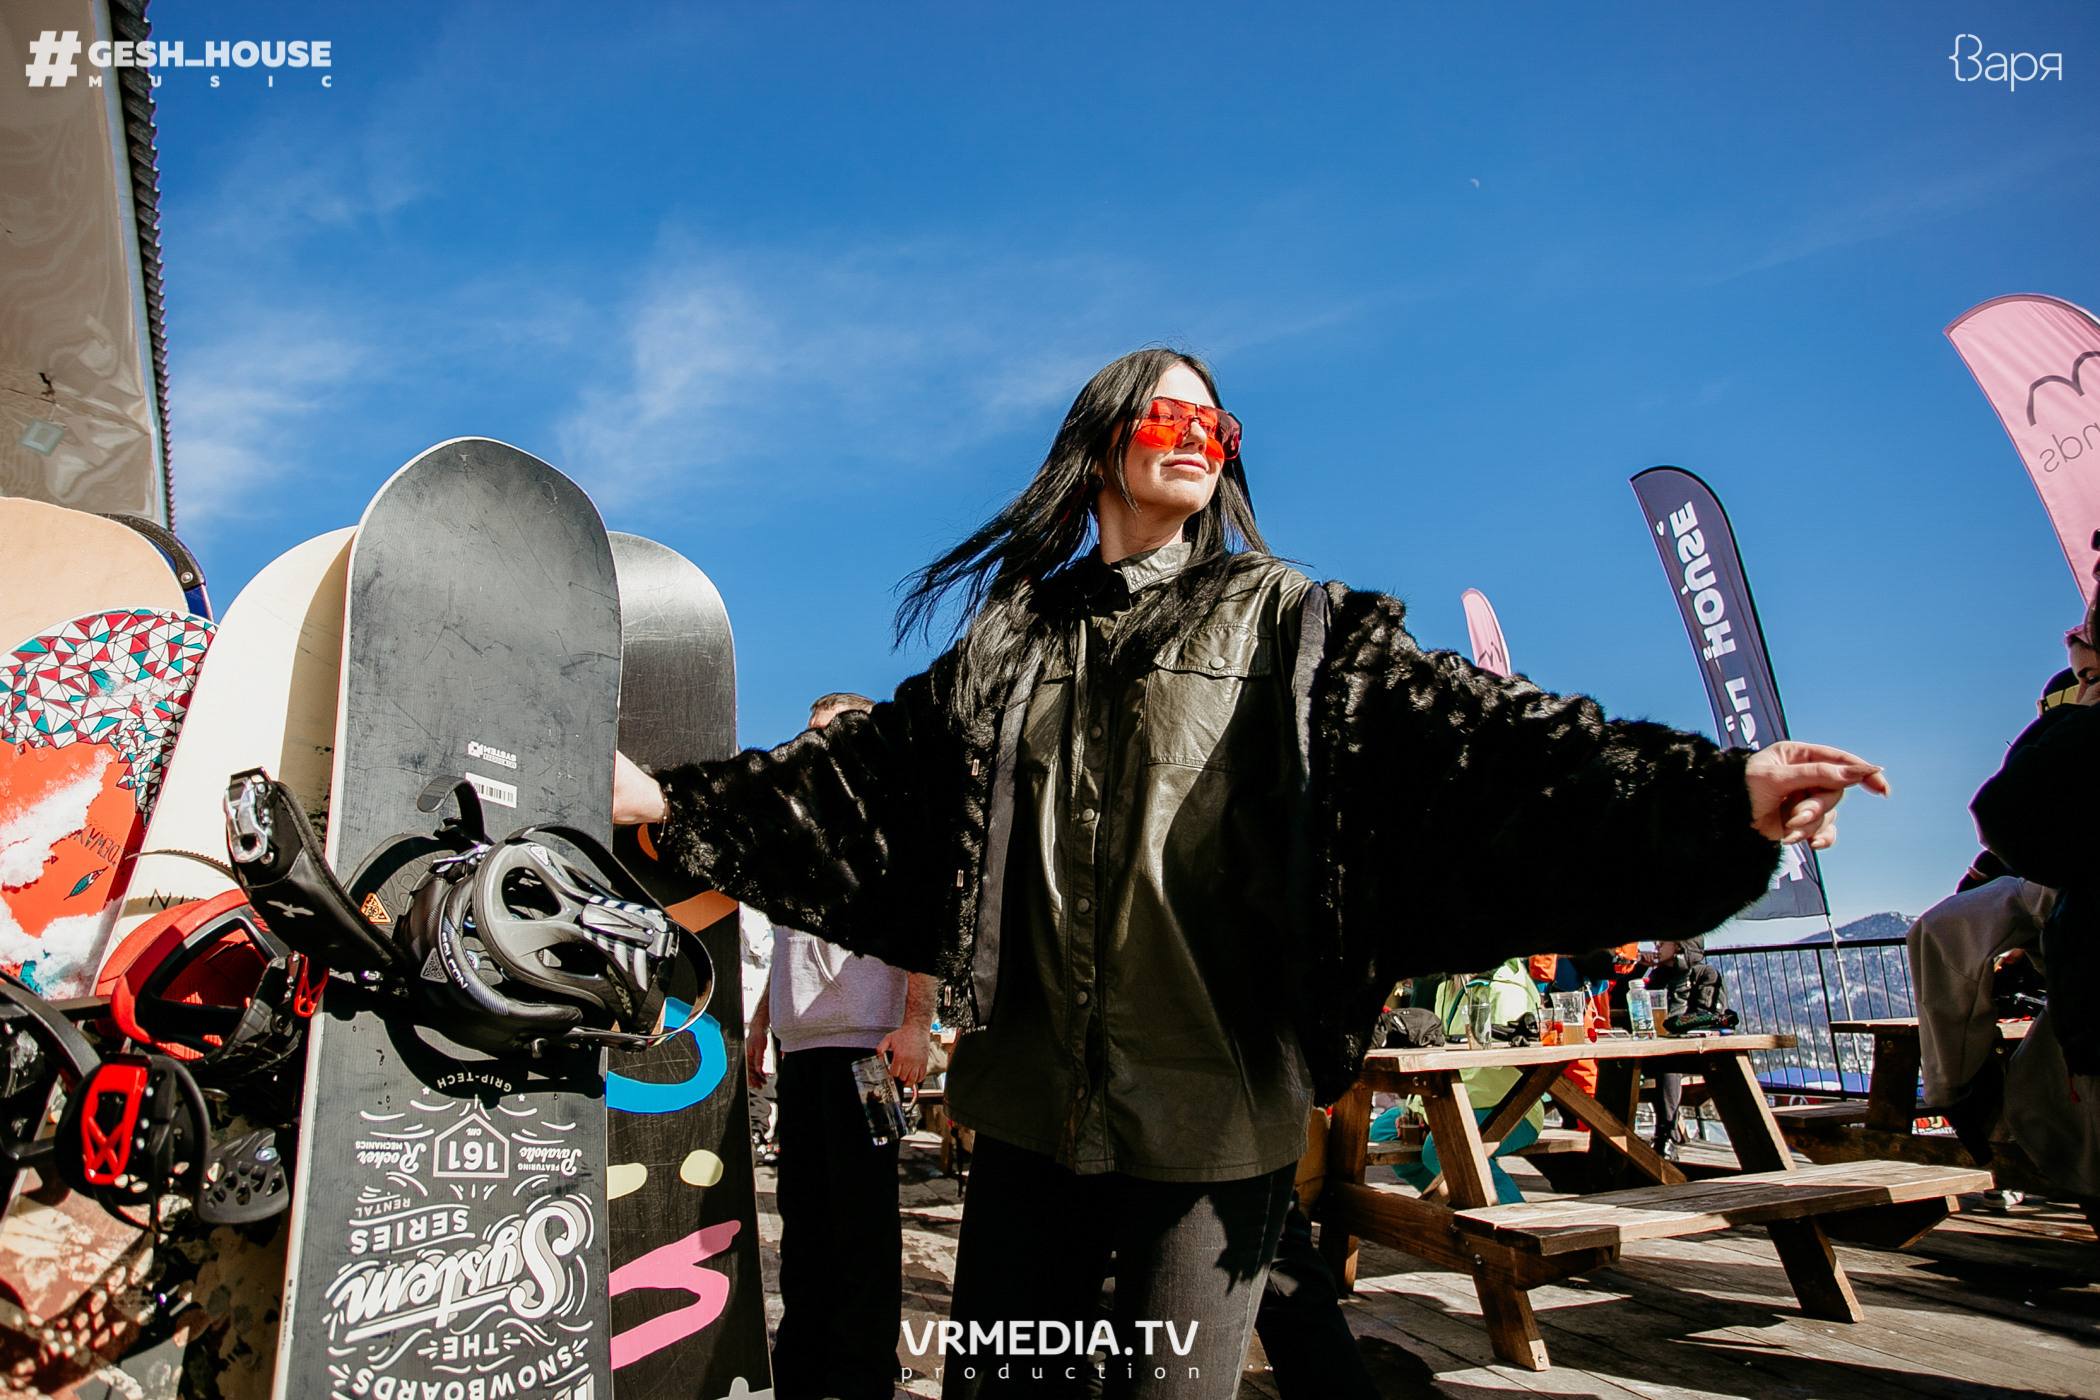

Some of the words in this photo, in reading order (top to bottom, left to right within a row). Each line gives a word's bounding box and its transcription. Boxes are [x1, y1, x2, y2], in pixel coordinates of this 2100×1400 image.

[436, 1072, 512, 1093] GRIP-TECH
[353, 1140, 403, 1150] MECHANICS
[357, 1140, 427, 1174] Rocker
[448, 1141, 500, 1171] 161
[518, 1162, 560, 1172] FEATURING
[354, 1197, 411, 1217] RENTAL
[350, 1208, 469, 1255] SERIES
[331, 1200, 587, 1343] System
[442, 1332, 500, 1361] THE
[351, 1345, 574, 1400] SNOWBOARDS
